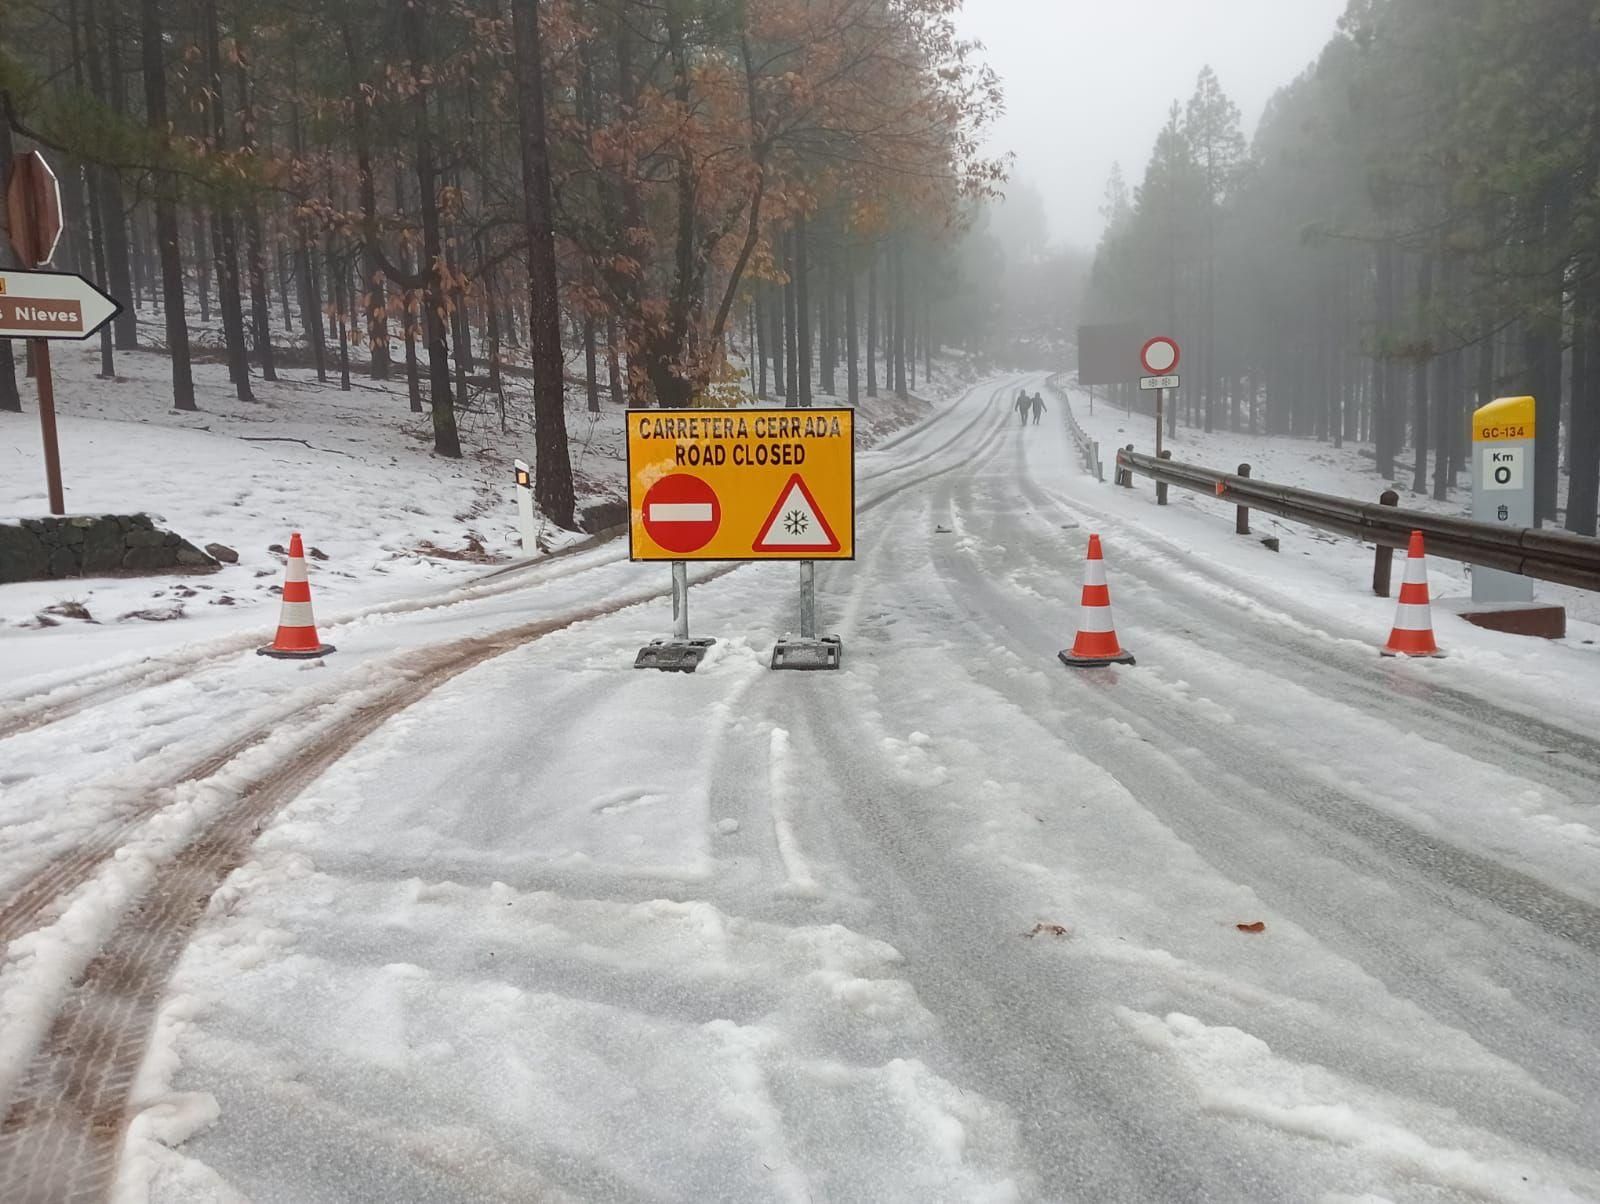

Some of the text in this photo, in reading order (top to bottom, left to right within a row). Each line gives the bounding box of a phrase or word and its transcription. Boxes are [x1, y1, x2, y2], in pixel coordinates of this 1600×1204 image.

[15, 307, 78, 322] Nieves
[640, 416, 841, 439] CARRETERA CERRADA
[1482, 427, 1524, 438] GC-134
[676, 444, 805, 466] ROAD CLOSED
[1492, 452, 1514, 462] Km
[1494, 466, 1511, 484] 0
